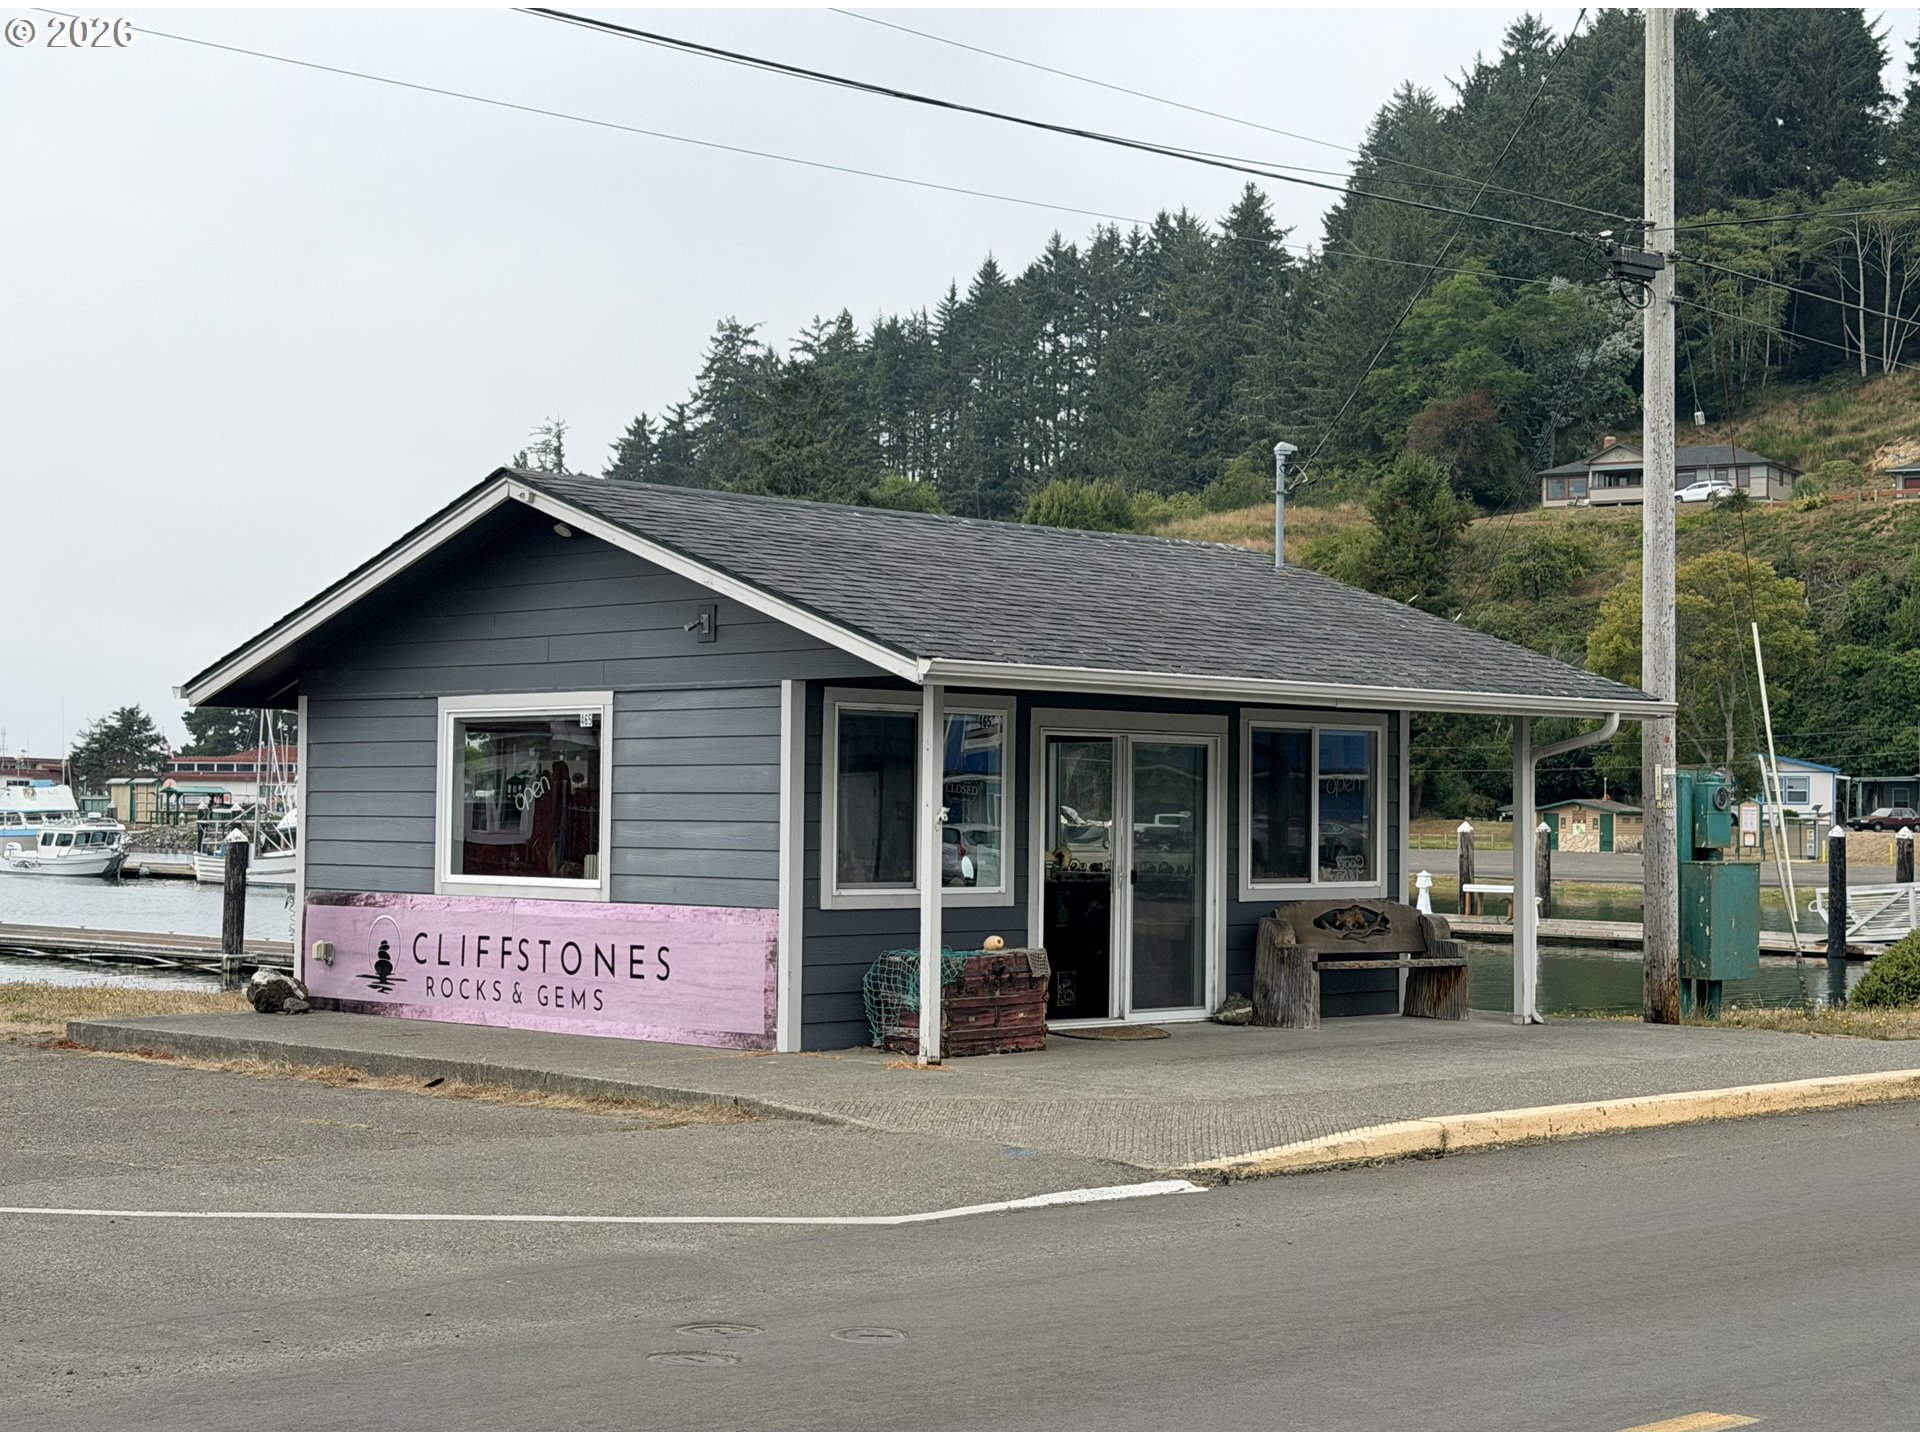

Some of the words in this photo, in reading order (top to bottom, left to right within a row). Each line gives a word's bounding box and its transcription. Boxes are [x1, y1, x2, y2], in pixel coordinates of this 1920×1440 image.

[580, 713, 592, 725] 465
[945, 783, 979, 795] CLOSED
[413, 932, 670, 981] CLIFFSTONES
[426, 976, 502, 1002] ROCKS
[512, 981, 522, 1004] &
[537, 985, 604, 1011] GEMS
